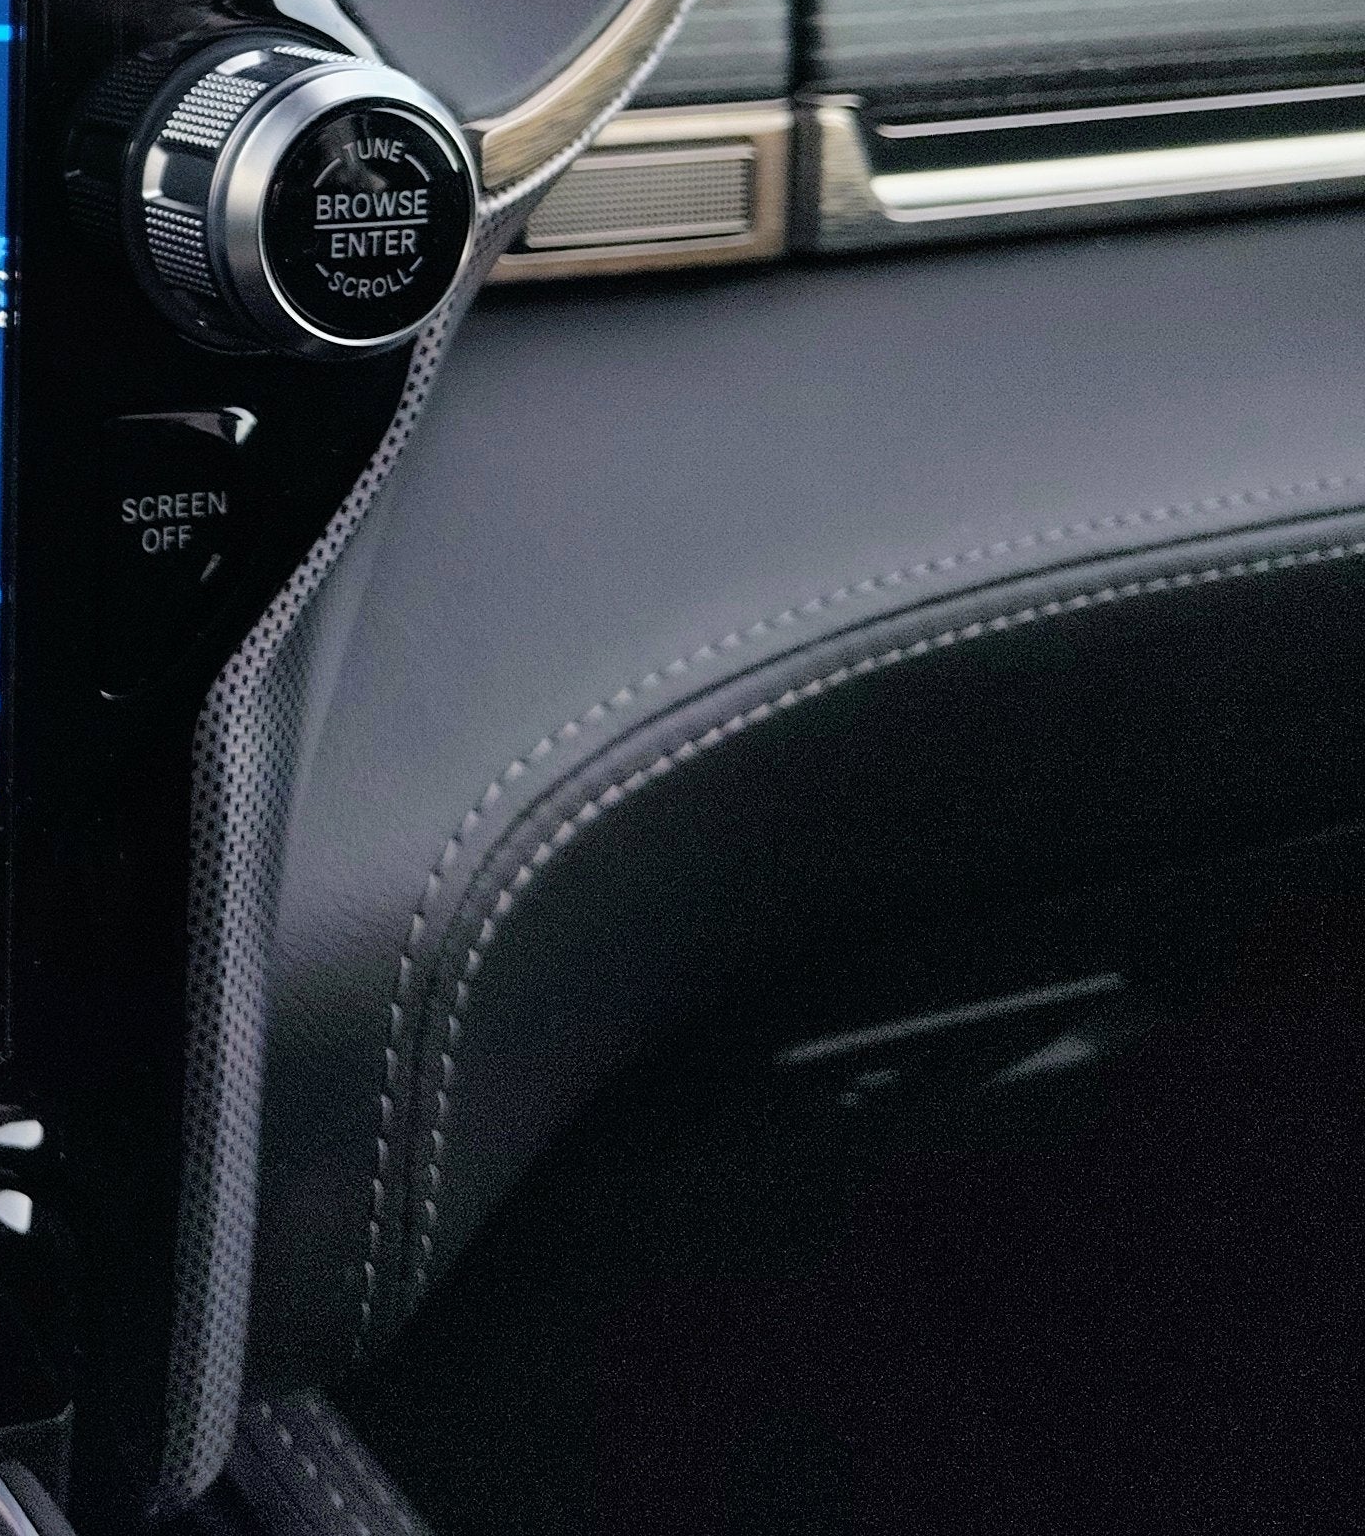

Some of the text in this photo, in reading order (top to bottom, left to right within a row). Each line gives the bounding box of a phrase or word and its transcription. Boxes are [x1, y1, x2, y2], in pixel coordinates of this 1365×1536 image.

[343, 138, 405, 164] TUNE
[316, 189, 429, 220] BROWSE
[330, 229, 416, 259] ENTER
[327, 269, 414, 300] SCROLL
[121, 491, 227, 523] SCREEN
[142, 525, 192, 554] OFF
